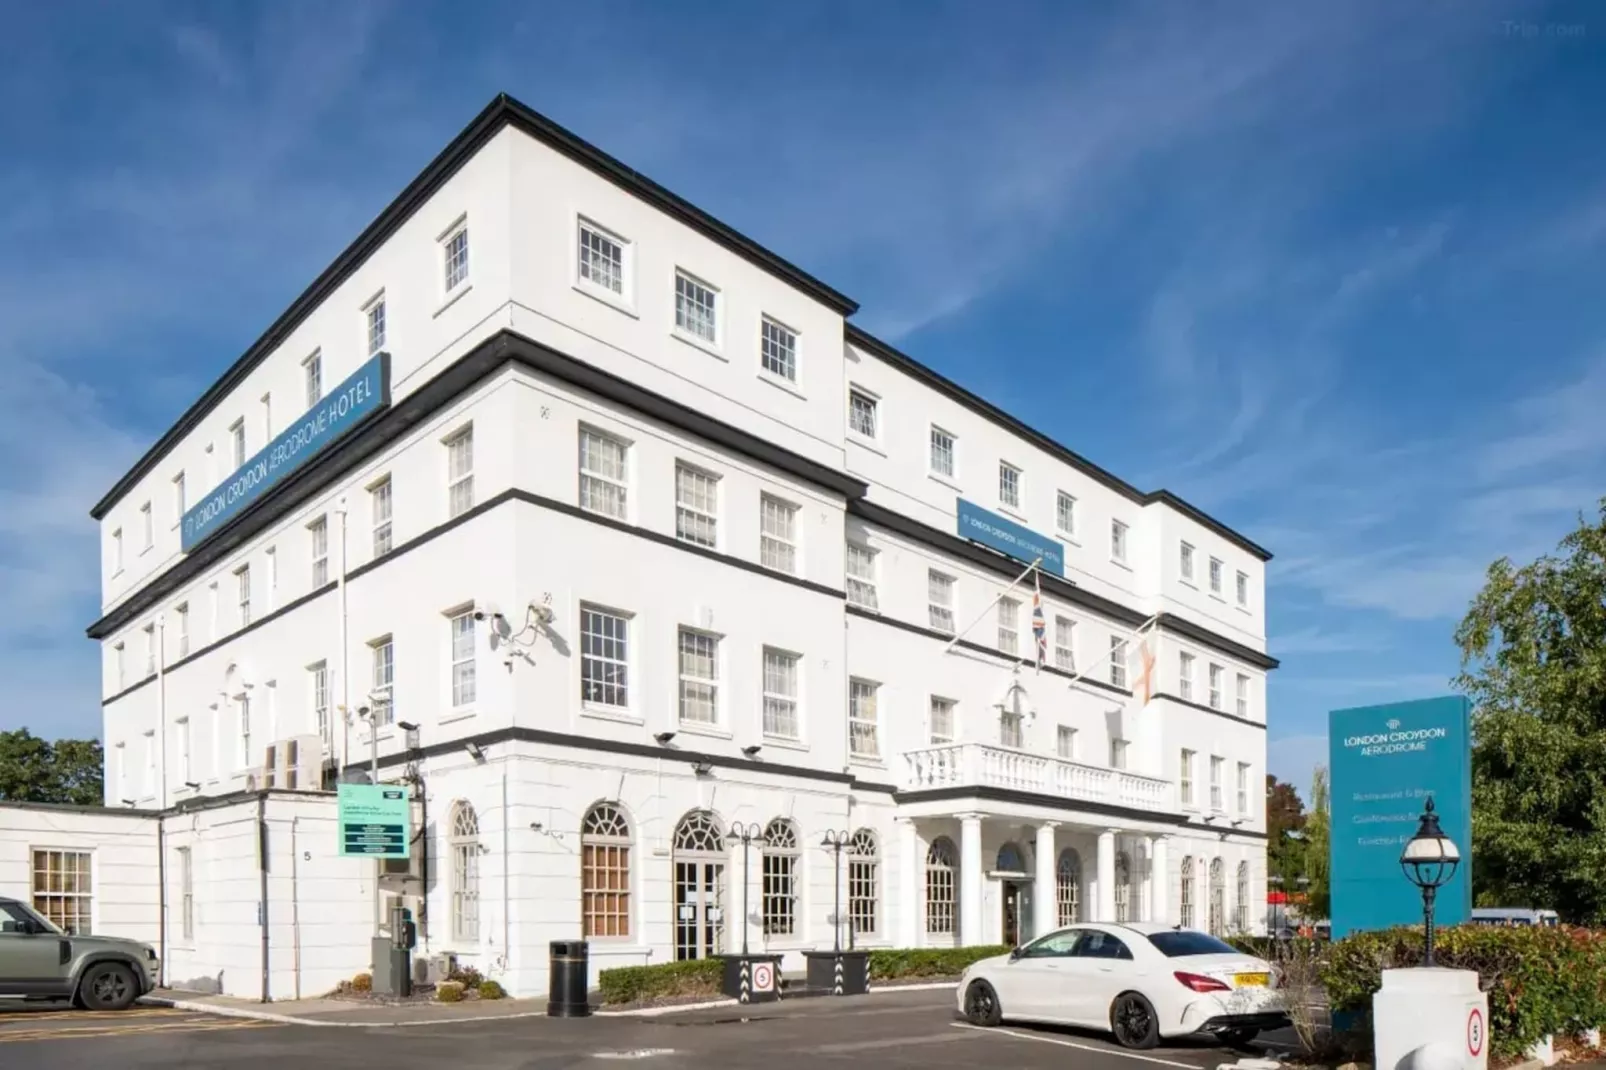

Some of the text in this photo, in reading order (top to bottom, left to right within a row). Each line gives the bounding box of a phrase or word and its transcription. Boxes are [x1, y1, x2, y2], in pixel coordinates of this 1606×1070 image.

[196, 376, 371, 530] LONDON CROYDON AERODROME HOTEL
[1343, 728, 1446, 747] LONDON CROYDON
[1360, 741, 1427, 756] AERODROME
[759, 972, 767, 982] 5
[1473, 1024, 1479, 1042] 5
